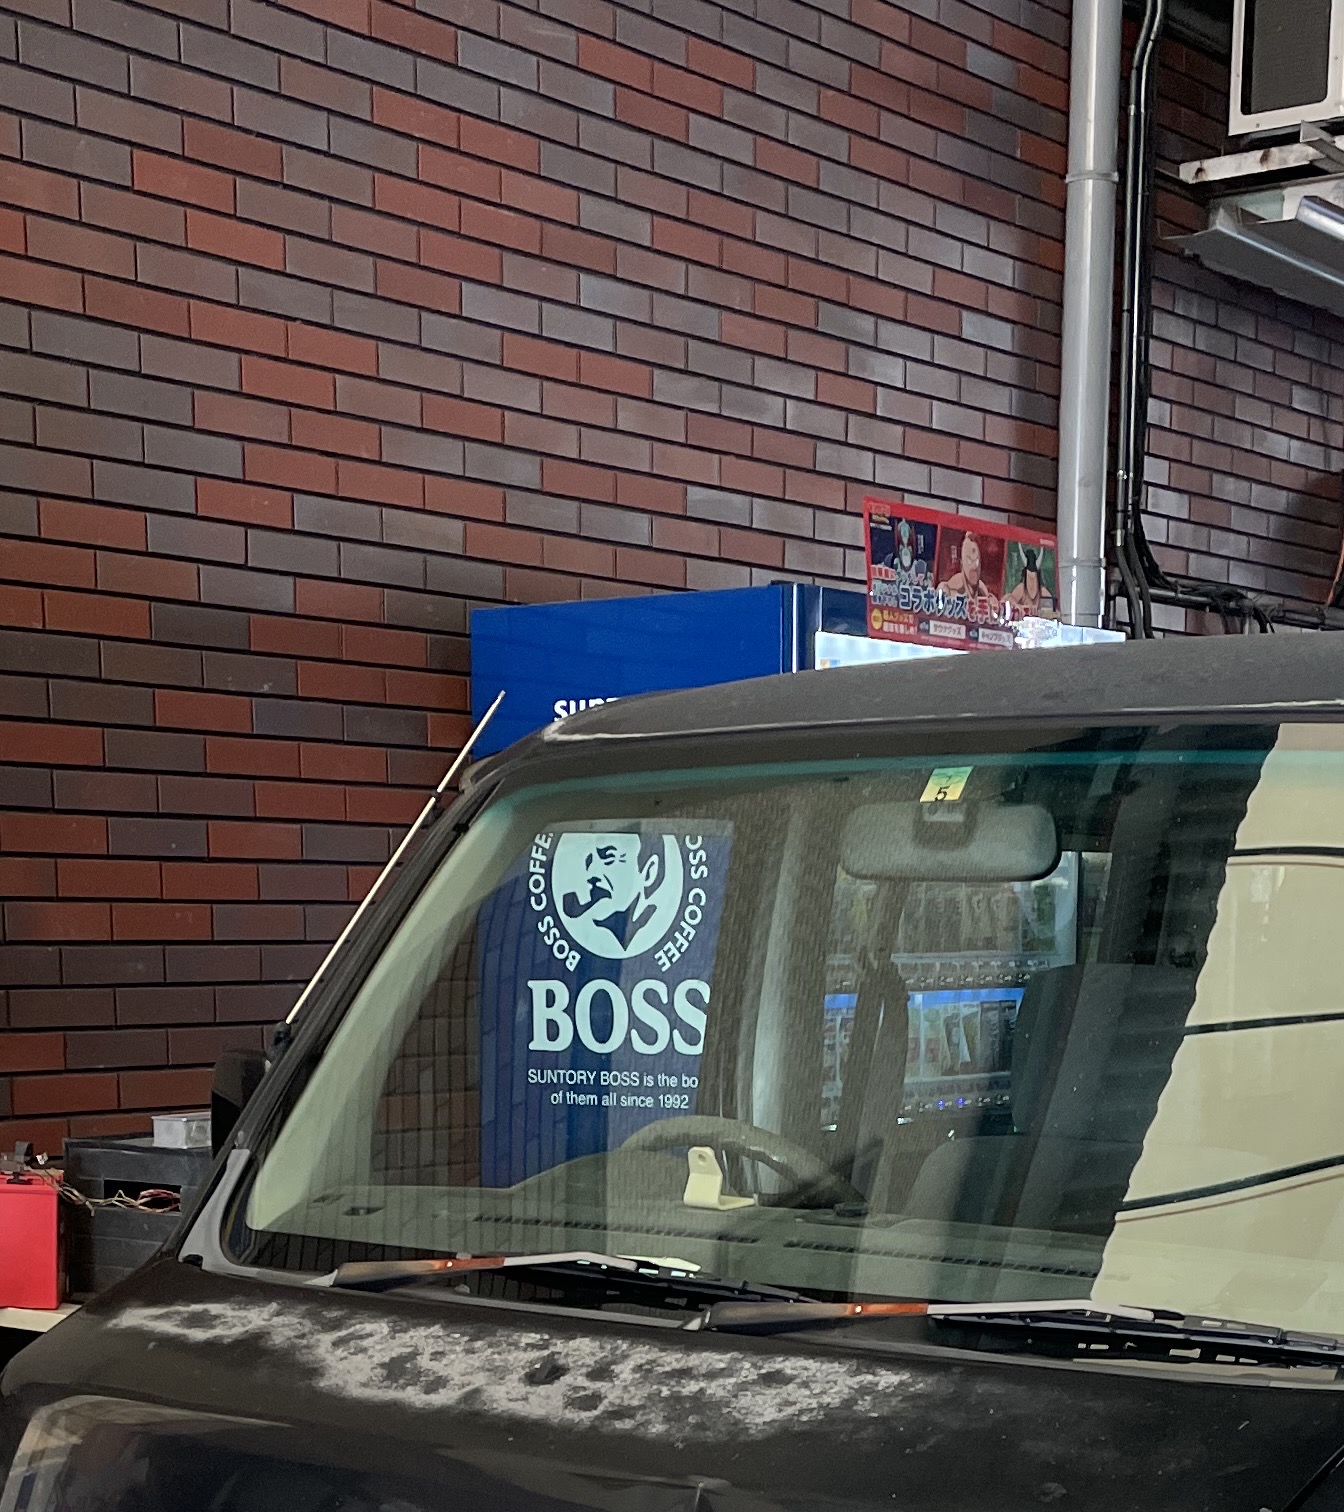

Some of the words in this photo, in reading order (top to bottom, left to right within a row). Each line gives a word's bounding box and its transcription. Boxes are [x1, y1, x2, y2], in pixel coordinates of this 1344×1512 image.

[528, 832, 554, 911] COFFE
[537, 915, 581, 972] BOSS
[654, 887, 707, 972] COFFEE
[527, 978, 711, 1056] BOSS
[528, 1068, 597, 1085] SUNTORY
[600, 1070, 640, 1087] BOSS
[643, 1072, 654, 1087] is
[657, 1072, 678, 1088] the
[550, 1090, 564, 1105] of
[565, 1090, 598, 1106] them
[601, 1091, 617, 1107] all
[620, 1093, 654, 1108] since
[658, 1094, 689, 1109] 1992
